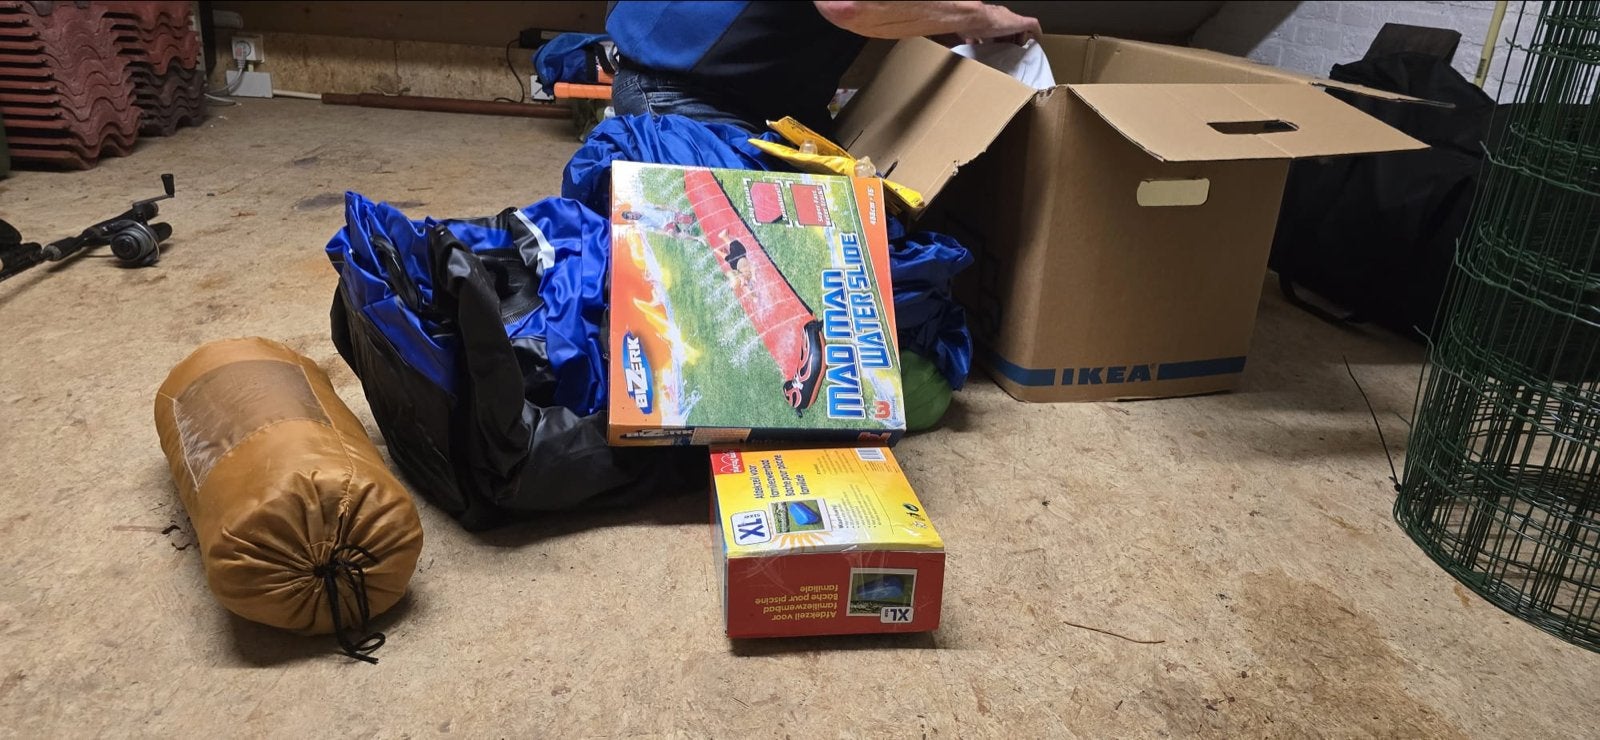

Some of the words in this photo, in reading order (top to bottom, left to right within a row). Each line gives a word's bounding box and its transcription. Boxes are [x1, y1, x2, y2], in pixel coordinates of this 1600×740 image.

[840, 232, 871, 291] SLIDE
[822, 269, 854, 339] MAN
[849, 292, 893, 368] WATER
[825, 344, 866, 419] MAD
[1061, 364, 1151, 386] IKEA
[774, 455, 787, 469] piscine
[749, 465, 759, 475] voor
[780, 470, 791, 480] pour
[761, 459, 780, 497] familiezwembad
[737, 518, 766, 540] XL
[800, 584, 839, 592] familiale
[755, 596, 790, 605] piscine
[790, 594, 810, 602] pour
[763, 602, 838, 614] familiezwembad
[890, 608, 910, 621] XL
[772, 613, 793, 621] voor
[794, 610, 837, 621] Afdekzeil
